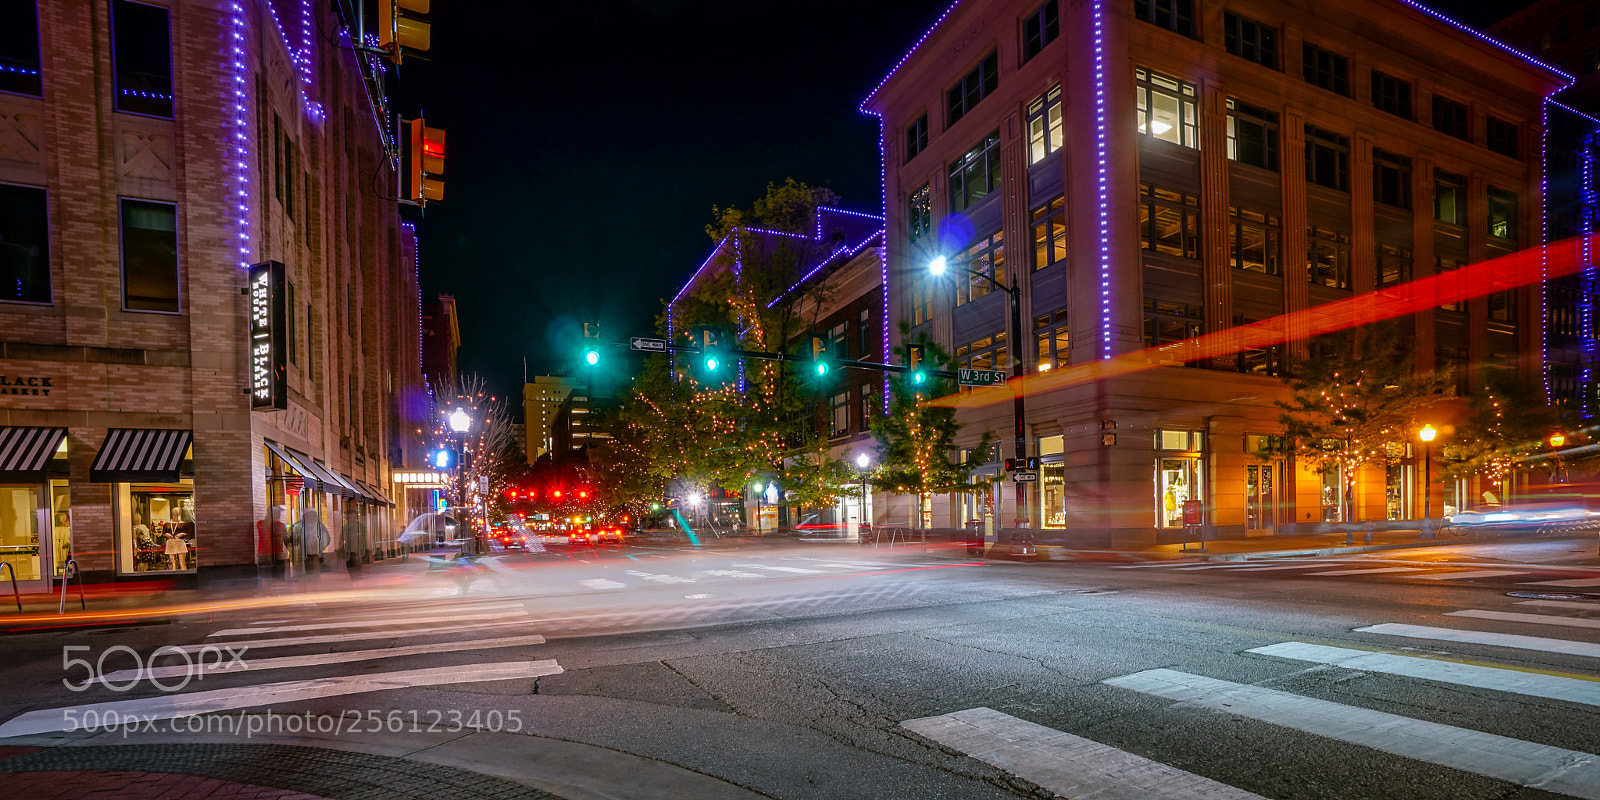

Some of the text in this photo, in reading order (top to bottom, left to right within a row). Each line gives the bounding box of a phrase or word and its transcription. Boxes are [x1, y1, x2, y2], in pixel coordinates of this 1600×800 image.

[252, 281, 261, 397] HOUSE MARKET
[258, 271, 269, 399] WHITE BLACK
[0, 375, 53, 387] LACK
[960, 369, 1004, 383] W 3rd St
[0, 388, 50, 396] ARKET
